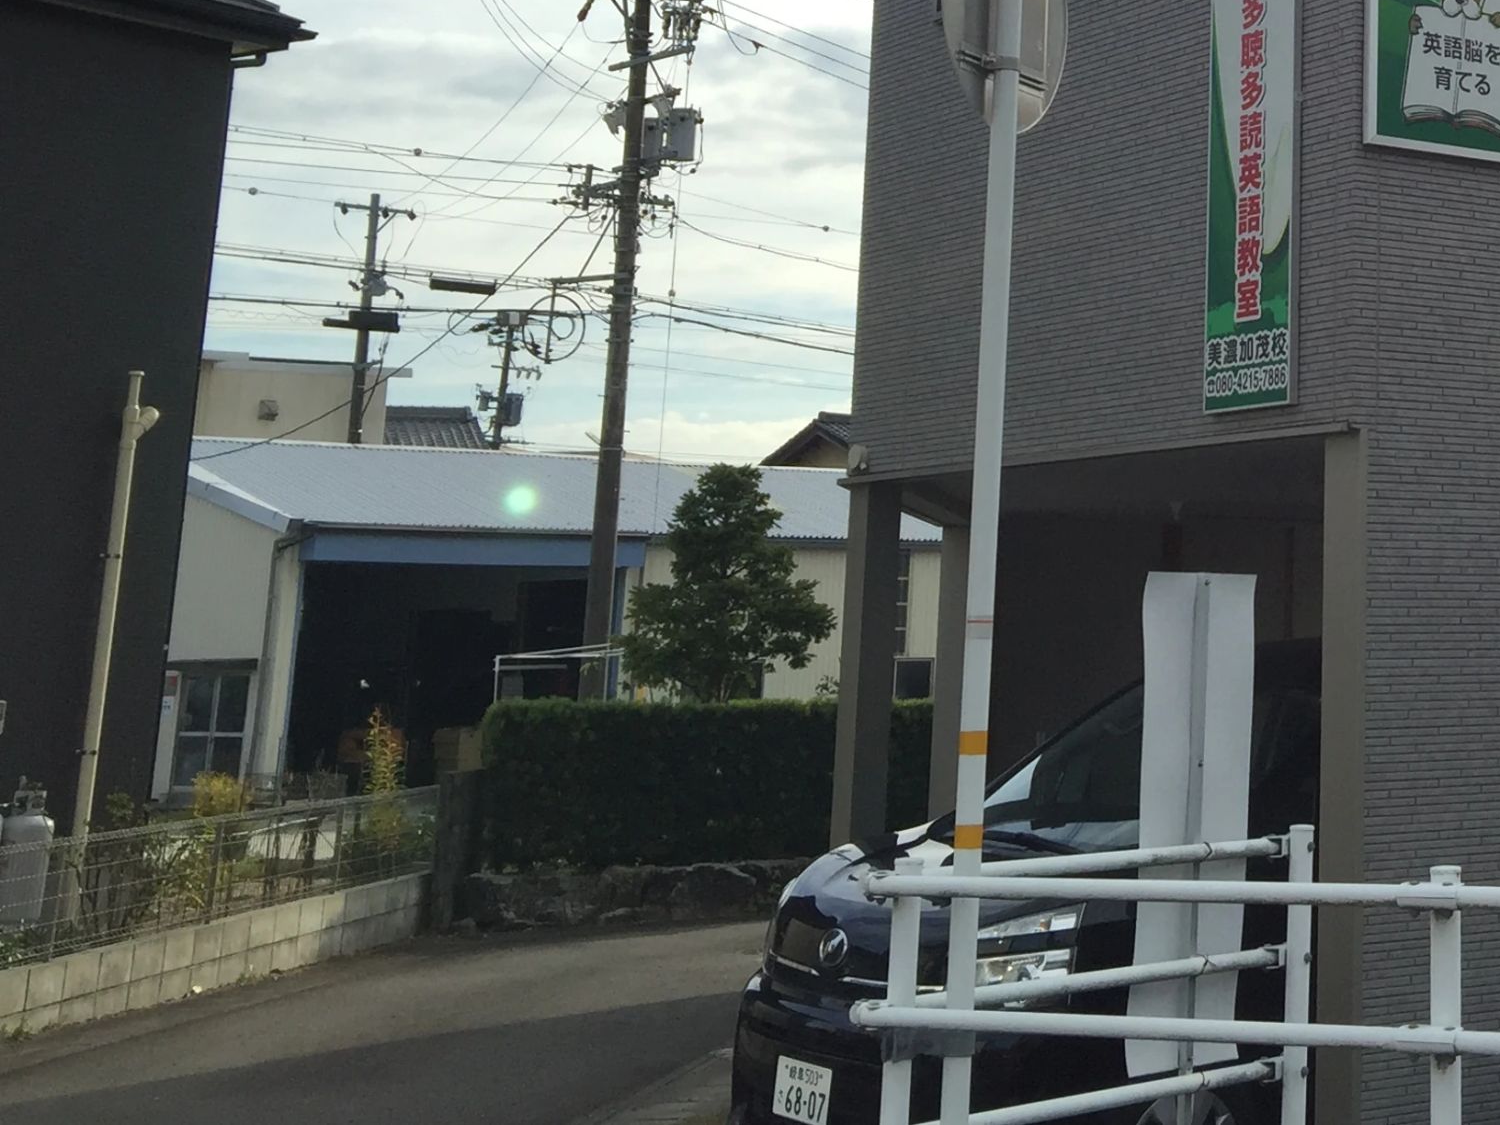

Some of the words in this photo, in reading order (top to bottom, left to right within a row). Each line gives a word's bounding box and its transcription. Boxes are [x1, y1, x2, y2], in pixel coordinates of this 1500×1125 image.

[1433, 65, 1492, 97] 育てる
[1207, 331, 1287, 367] 美濃加茂校
